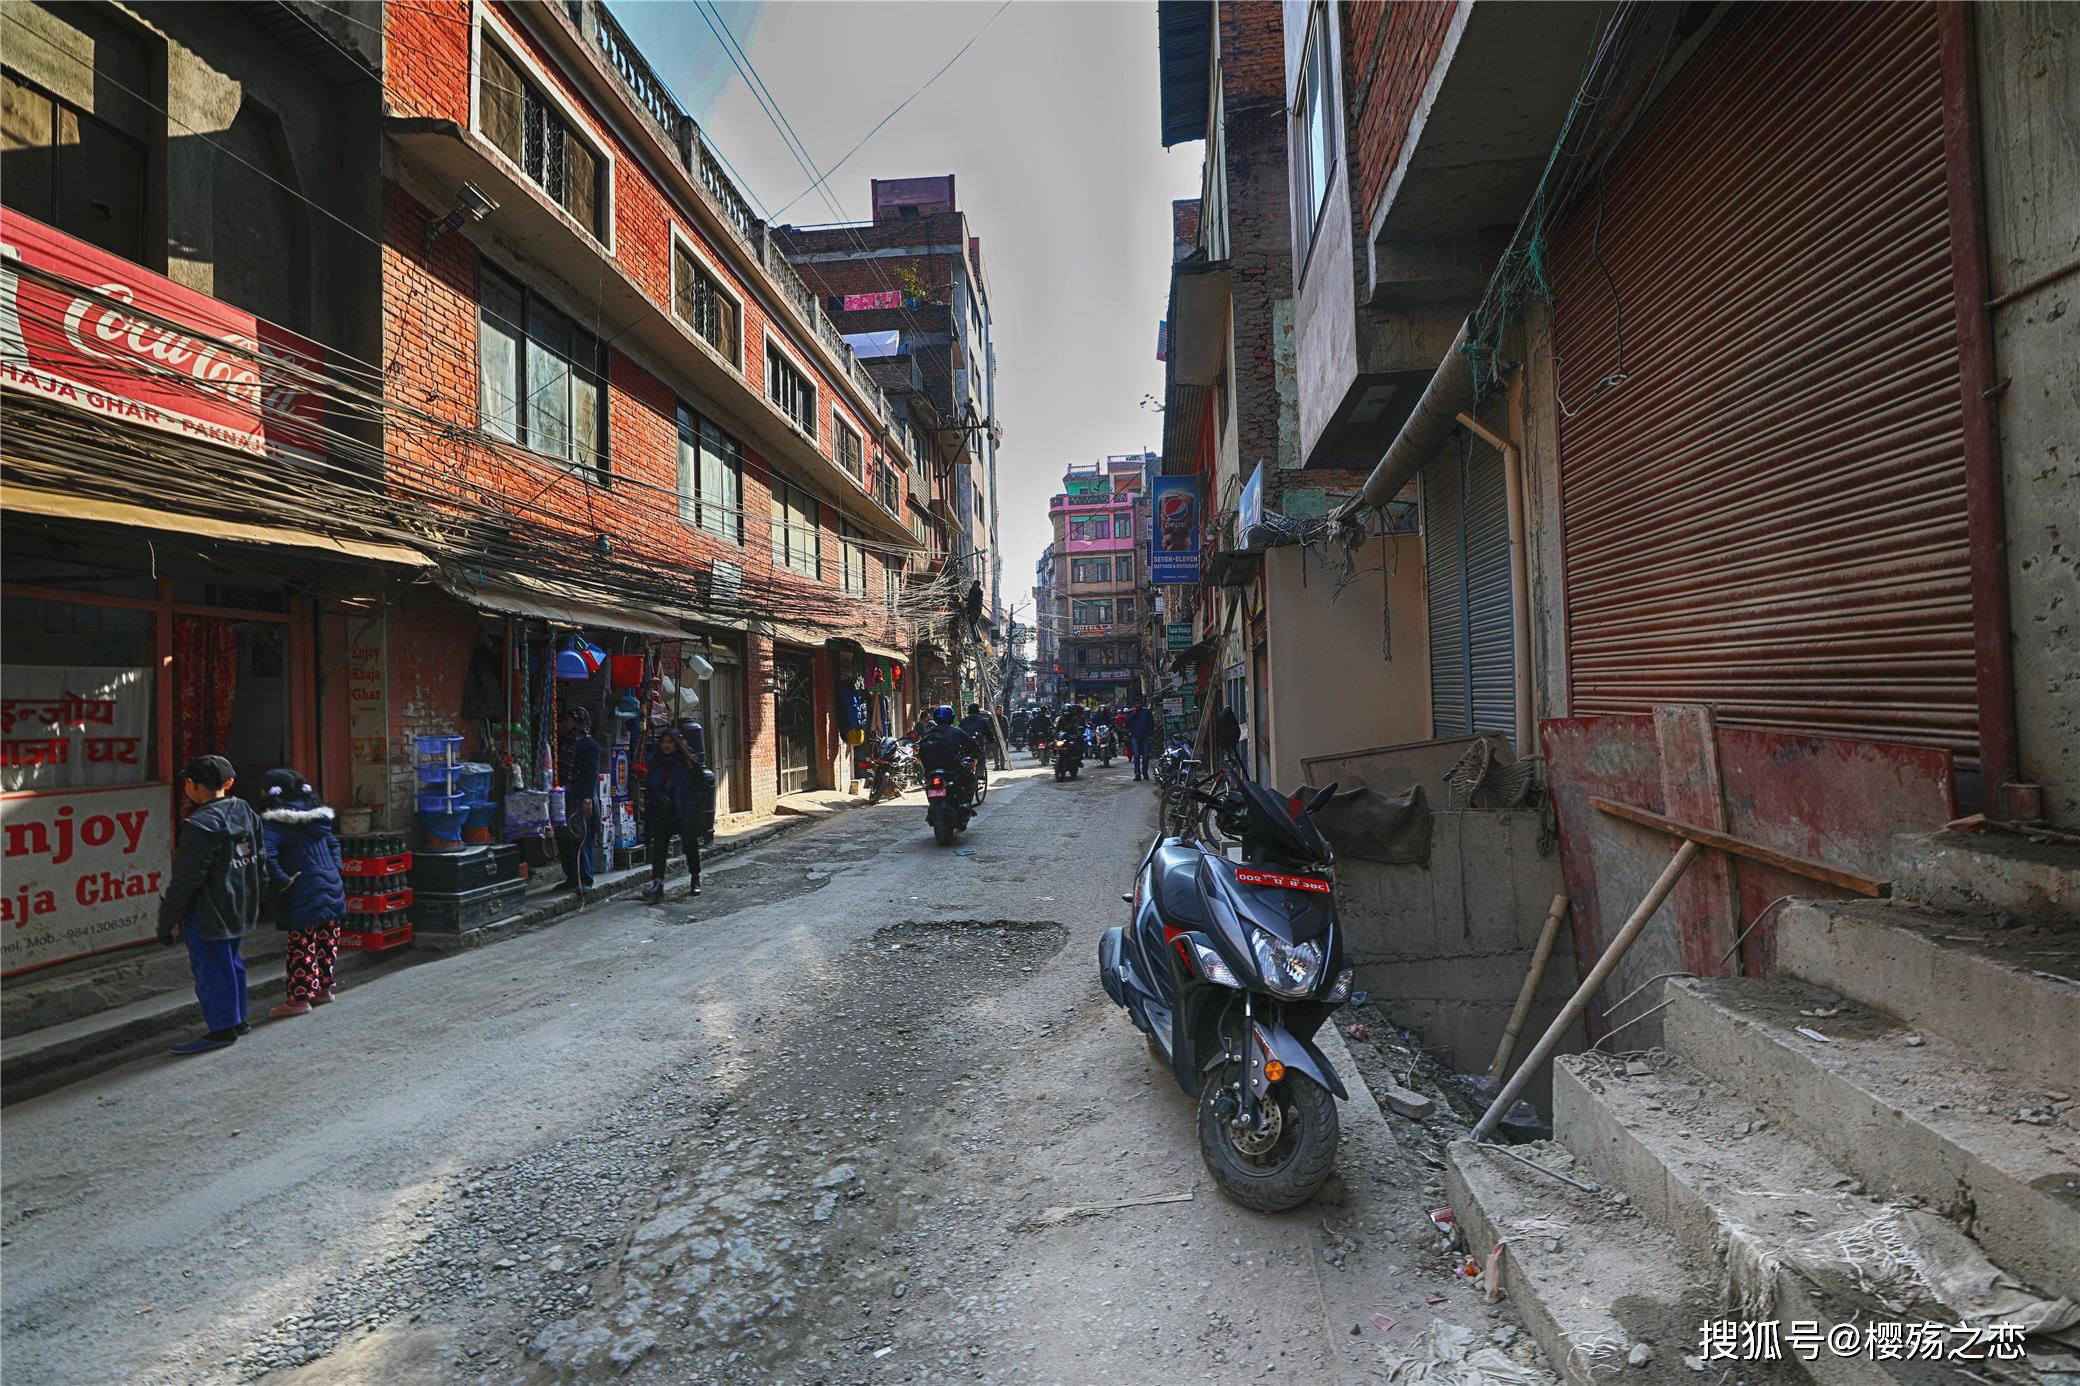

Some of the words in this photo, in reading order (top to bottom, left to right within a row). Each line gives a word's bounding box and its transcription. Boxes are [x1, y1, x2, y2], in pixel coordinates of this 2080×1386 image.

[86, 391, 160, 424] GHAR
[1164, 521, 1186, 529] pepsi
[352, 647, 380, 662] Enjoy
[352, 667, 380, 682] Khaja
[352, 687, 380, 700] Ghar
[83, 737, 141, 765] घर
[5, 806, 149, 864] njoy
[76, 871, 161, 907] Ghar
